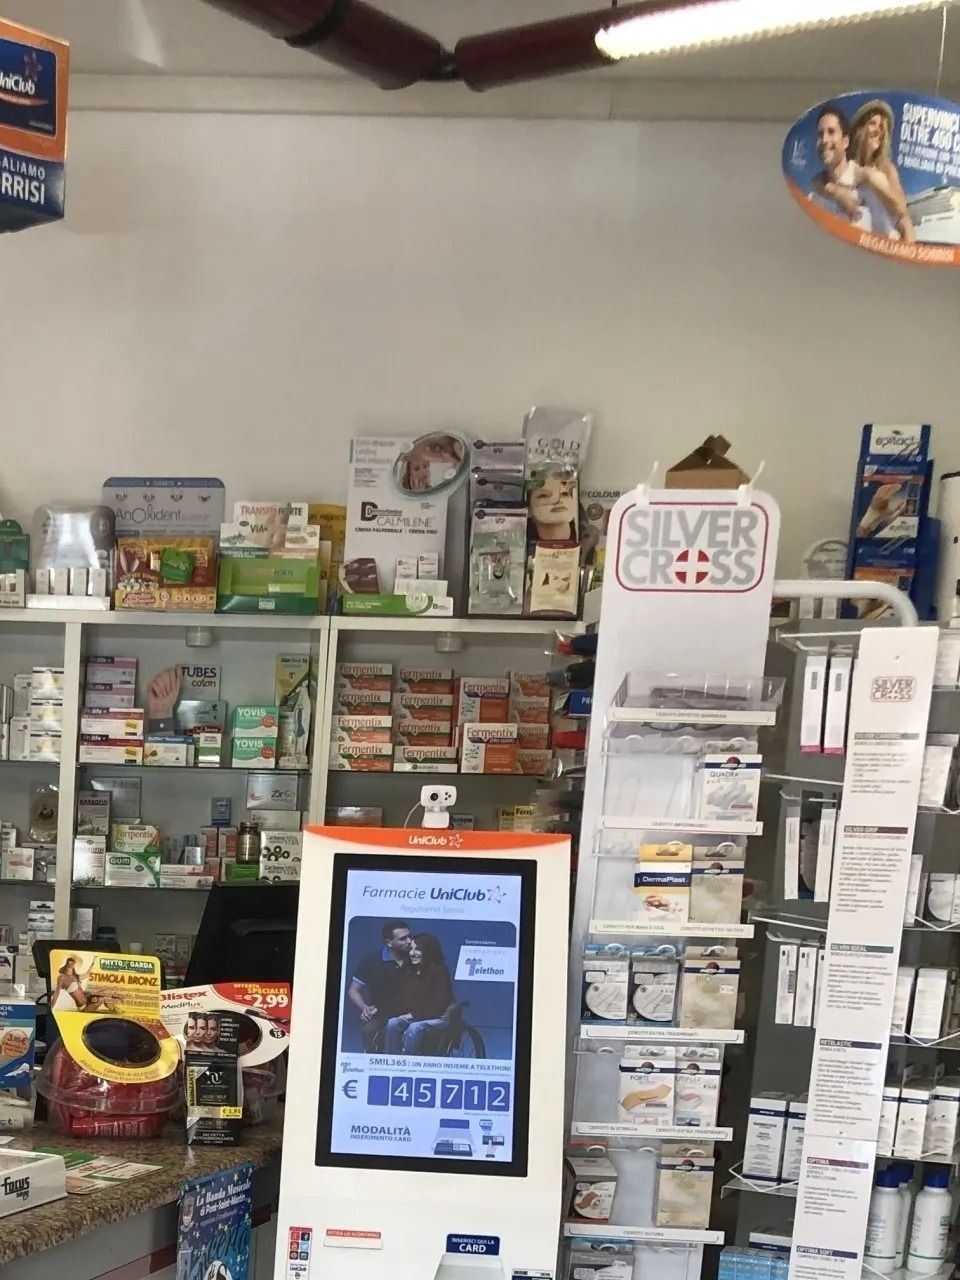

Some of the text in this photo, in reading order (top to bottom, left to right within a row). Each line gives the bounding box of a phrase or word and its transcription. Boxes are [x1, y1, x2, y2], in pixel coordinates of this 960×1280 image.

[626, 510, 759, 549] SILVER
[181, 666, 217, 678] TUBES
[874, 678, 913, 691] SILVER
[238, 707, 266, 717] YOVIS
[235, 738, 263, 748] YOVIS
[408, 835, 447, 846] UniClub
[642, 876, 686, 884] DermaPlast
[362, 885, 486, 902] Farmacie UniClub
[130, 961, 153, 969] GARDA
[465, 958, 505, 976] Telethon
[89, 972, 126, 984] STIMOLA
[350, 1123, 411, 1136] MODALITÀ
[350, 1134, 393, 1142] INSERIMENTO
[0, 1176, 30, 1196] focus
[459, 1243, 486, 1253] CARD
